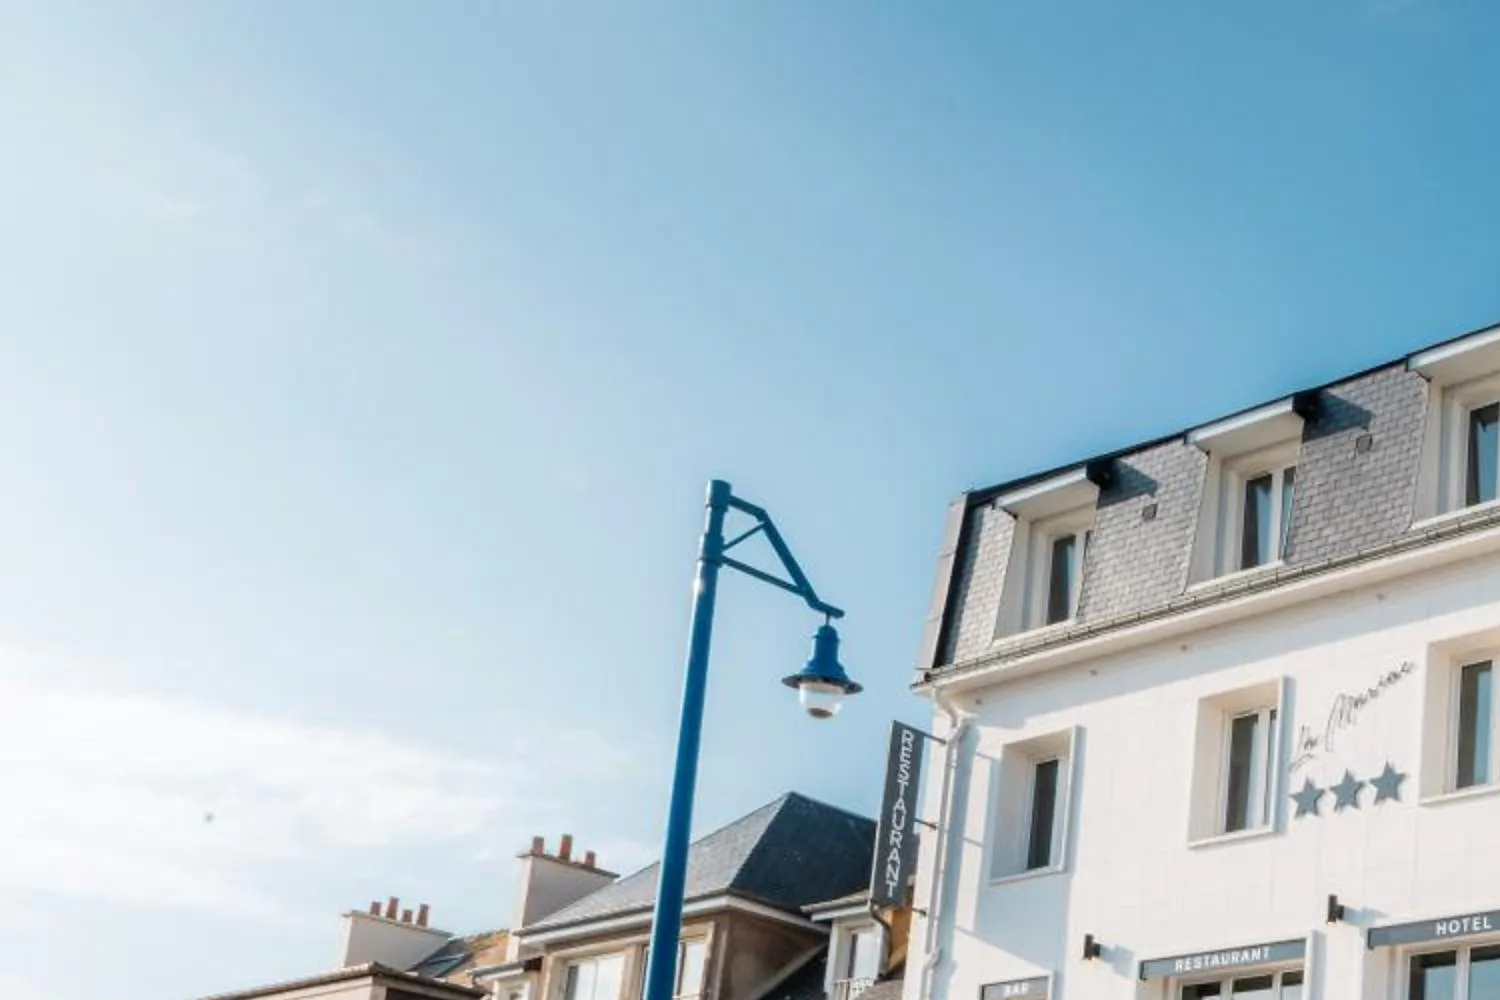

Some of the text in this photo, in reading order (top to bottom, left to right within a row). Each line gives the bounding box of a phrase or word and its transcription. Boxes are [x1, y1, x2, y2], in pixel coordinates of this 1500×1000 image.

[886, 729, 914, 898] RESTAURANT
[1435, 914, 1492, 936] HOTEL
[1174, 947, 1270, 973] RESTAURANT
